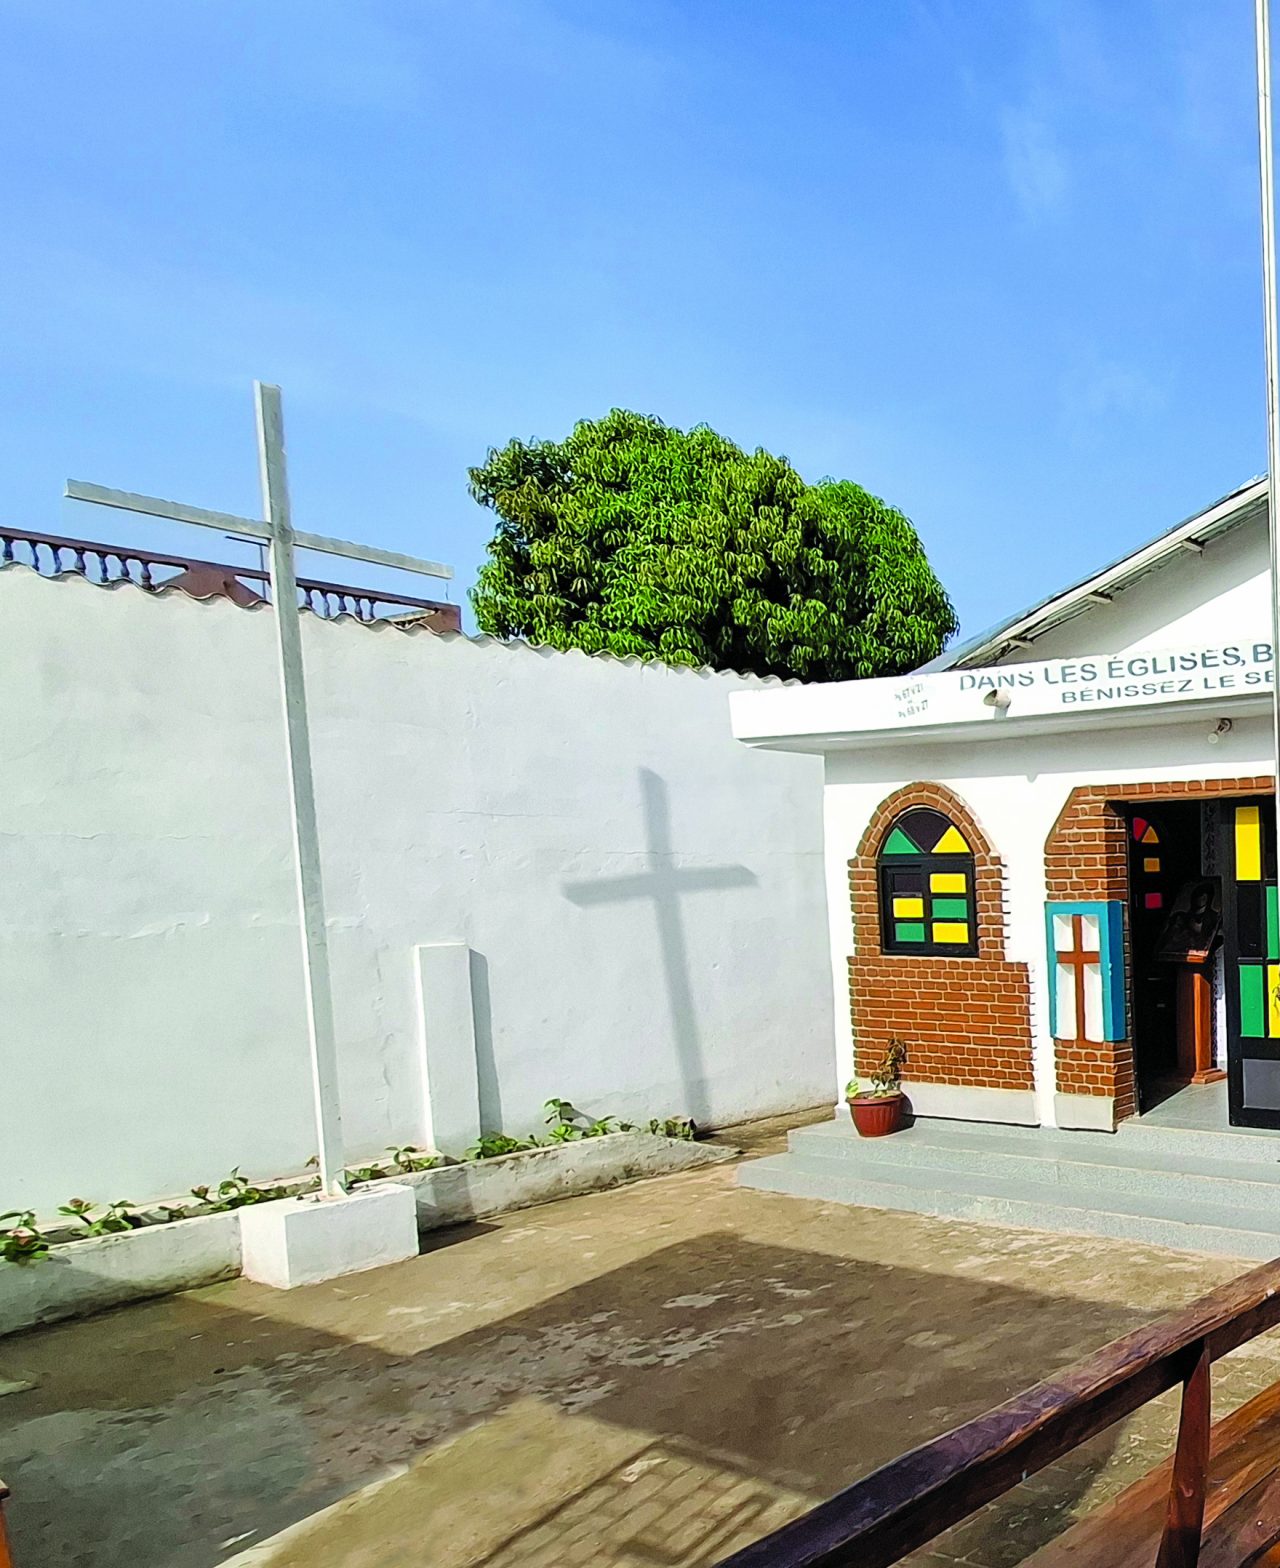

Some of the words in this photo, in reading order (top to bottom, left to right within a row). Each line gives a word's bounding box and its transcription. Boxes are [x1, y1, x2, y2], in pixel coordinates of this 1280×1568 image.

[960, 671, 1035, 691] DANS
[1044, 663, 1098, 685] LES
[1107, 646, 1246, 679] ÉGLISES,
[1061, 679, 1195, 704] BÉNISSEZ
[1203, 674, 1236, 690] LE
